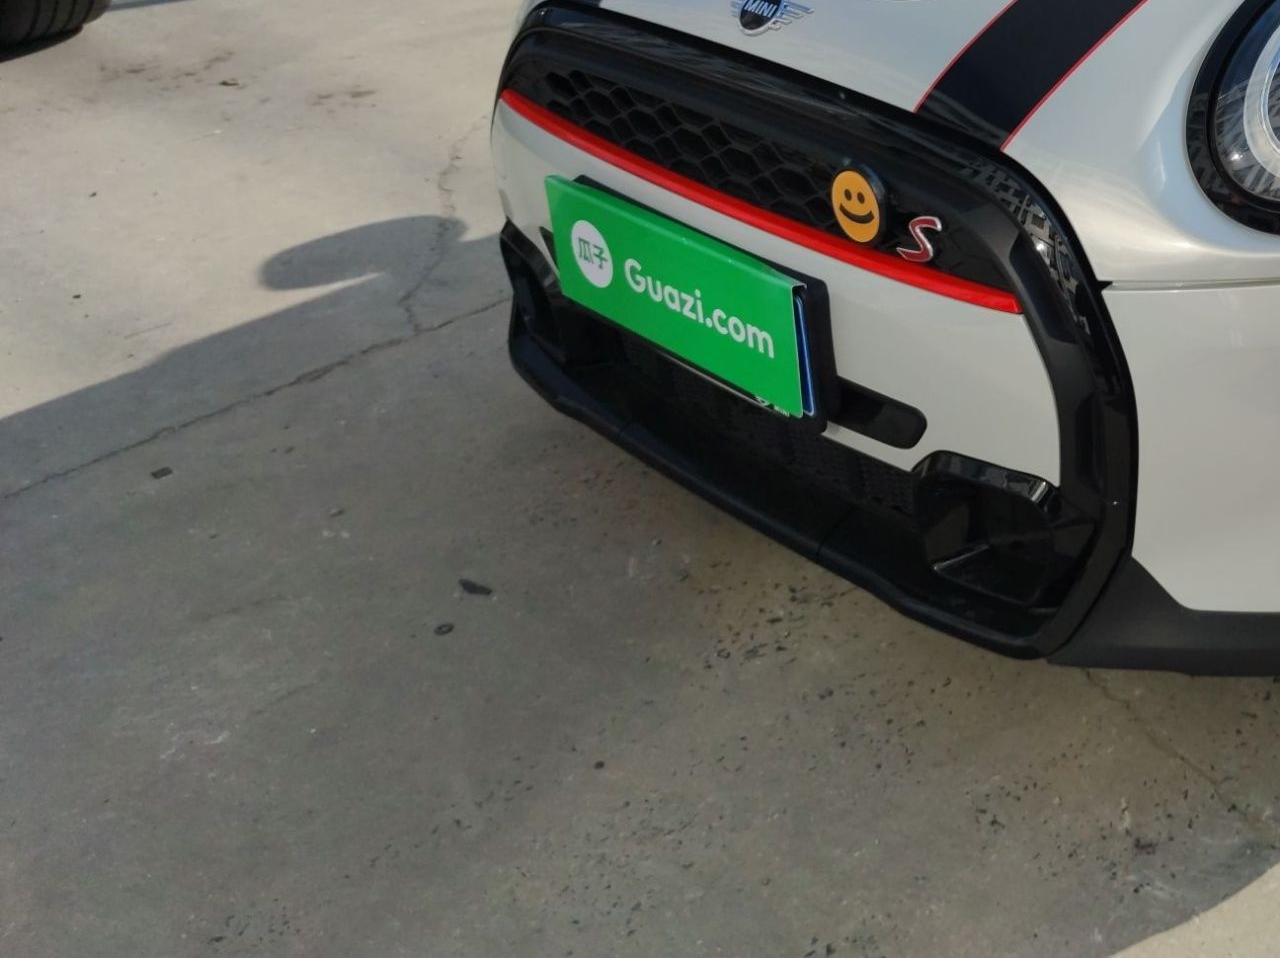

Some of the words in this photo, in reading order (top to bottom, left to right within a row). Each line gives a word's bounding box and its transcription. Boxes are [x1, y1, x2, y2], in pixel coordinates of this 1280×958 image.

[578, 237, 608, 270] 瓜子
[896, 216, 942, 262] S
[624, 258, 775, 359] Guazi.com
